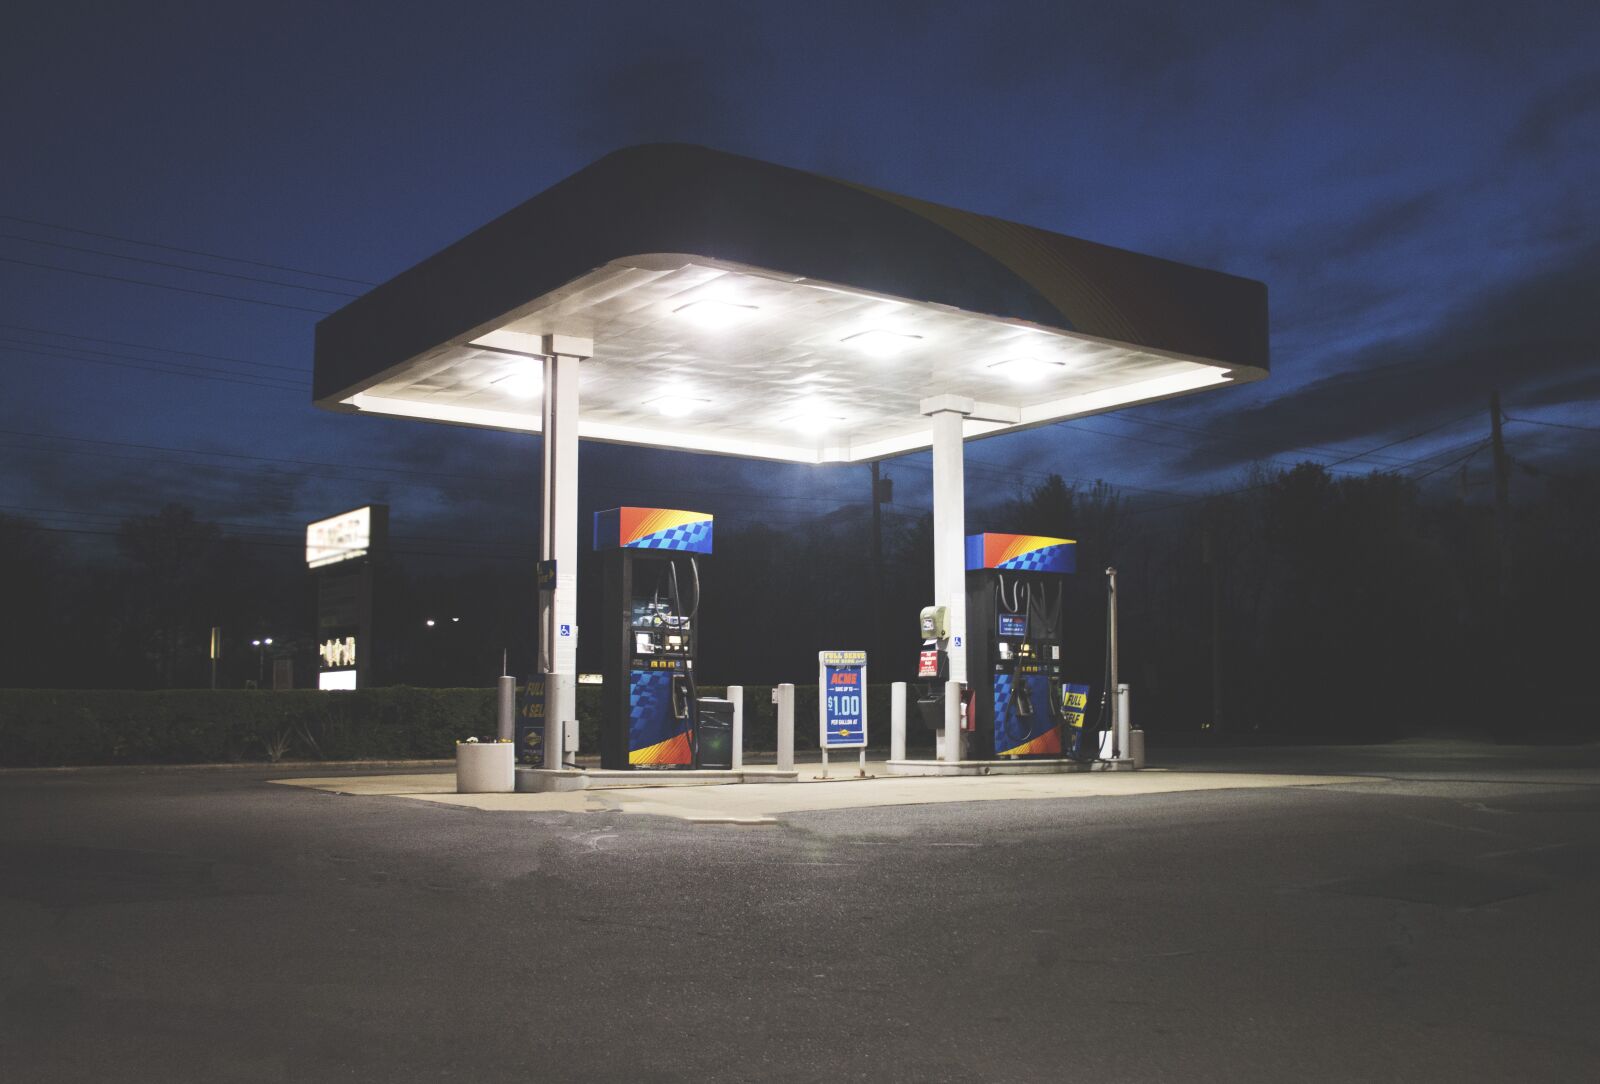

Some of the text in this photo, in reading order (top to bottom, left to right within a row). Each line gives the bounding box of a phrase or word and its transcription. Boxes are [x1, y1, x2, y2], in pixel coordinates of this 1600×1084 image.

[831, 673, 857, 685] ACME
[827, 695, 860, 716] $1.00
[1067, 695, 1081, 706] FULL
[528, 704, 545, 718] SEL
